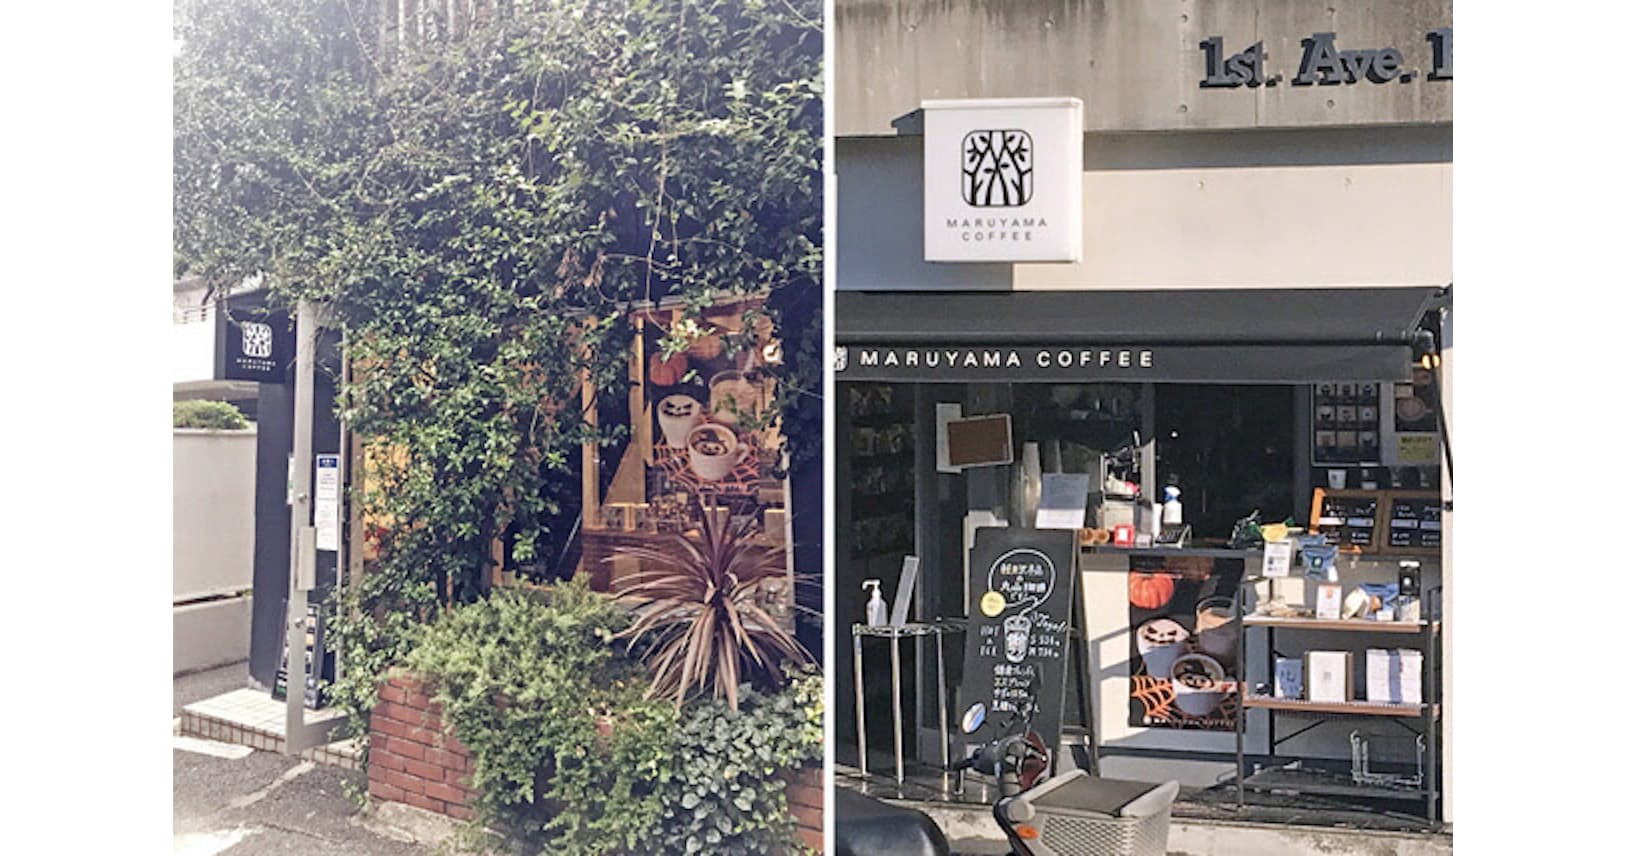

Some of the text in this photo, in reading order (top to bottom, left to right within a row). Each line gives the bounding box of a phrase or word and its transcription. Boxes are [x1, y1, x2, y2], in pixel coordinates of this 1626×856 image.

[1199, 35, 1283, 88] 1st.
[1291, 32, 1418, 85] Ave.
[946, 218, 1048, 228] MARUYAMA
[961, 231, 1033, 242] COFFEE
[859, 350, 1154, 368] MARUYAMA COFFEE
